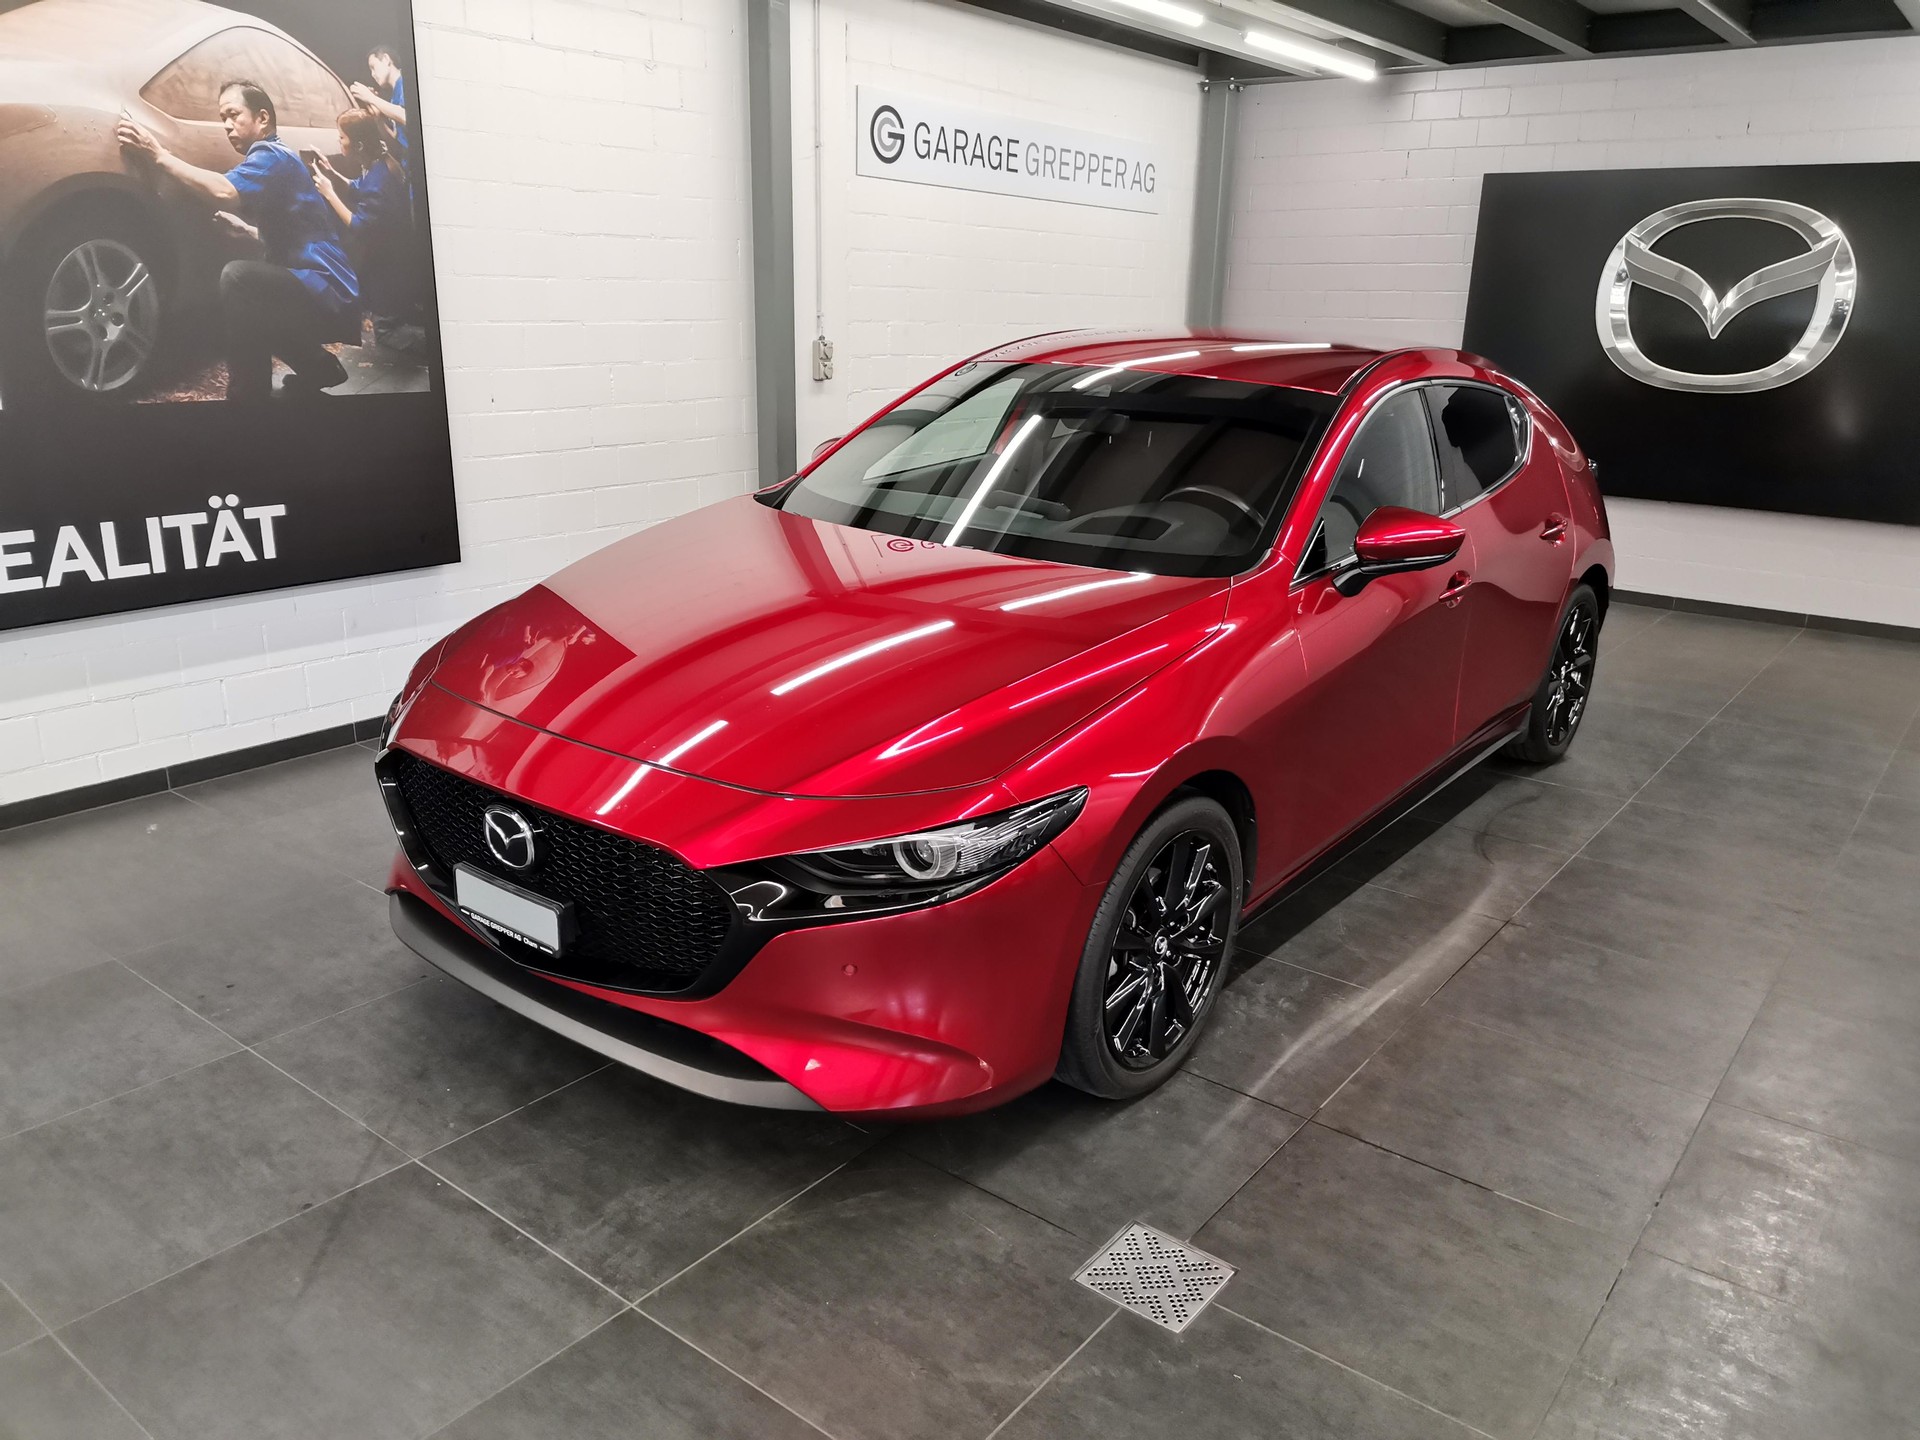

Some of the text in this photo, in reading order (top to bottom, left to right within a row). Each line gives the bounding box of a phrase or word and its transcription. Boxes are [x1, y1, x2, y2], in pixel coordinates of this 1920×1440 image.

[914, 121, 1156, 193] GARAGE GREPPER AG
[0, 493, 287, 594] EALITÄT
